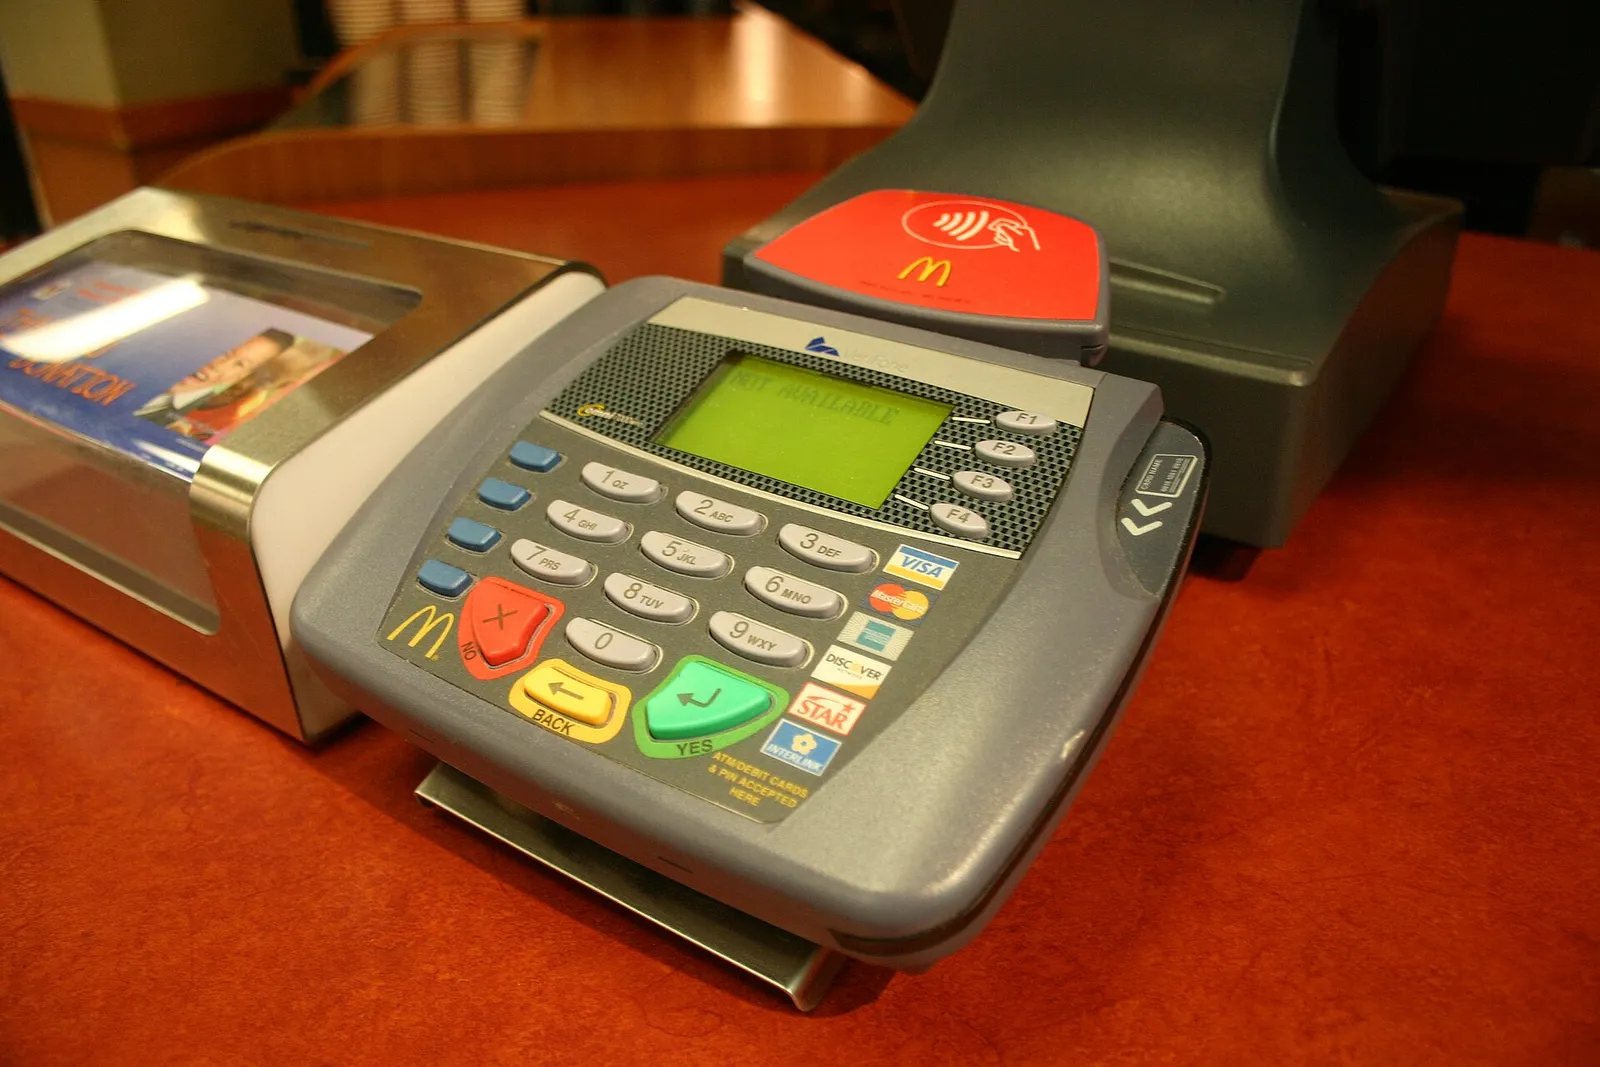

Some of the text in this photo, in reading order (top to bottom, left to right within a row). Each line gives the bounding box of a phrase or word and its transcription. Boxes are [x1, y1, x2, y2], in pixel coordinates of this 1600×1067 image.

[729, 369, 900, 424] NOT AVAILABLE
[1016, 411, 1039, 425] F1
[992, 441, 1016, 455] F2
[601, 470, 616, 484] 1
[1148, 459, 1163, 475] NAME
[970, 474, 995, 490] F3
[563, 508, 598, 532] 4 GHI
[694, 499, 735, 524] 2 ABC
[946, 508, 969, 524] F4
[525, 546, 562, 571] 7 PRS
[661, 541, 697, 566] 5 JKL
[799, 533, 842, 559] 3 DEF
[901, 555, 944, 579] VISA
[623, 582, 665, 610] 8 TUV
[764, 575, 813, 606] 6 MNO
[870, 589, 929, 616] MasterCard
[729, 620, 779, 652] 9 WXY
[460, 640, 477, 661] NO
[826, 653, 884, 681] DISCOVER
[532, 708, 573, 736] BACK
[796, 698, 850, 730] STAR
[676, 739, 713, 755] YES
[765, 742, 824, 773] INTERLINK
[707, 764, 798, 808] & PIN ACCEPTED
[712, 752, 810, 799] ATM/DEBIT CARDS
[728, 787, 761, 807] HERE
